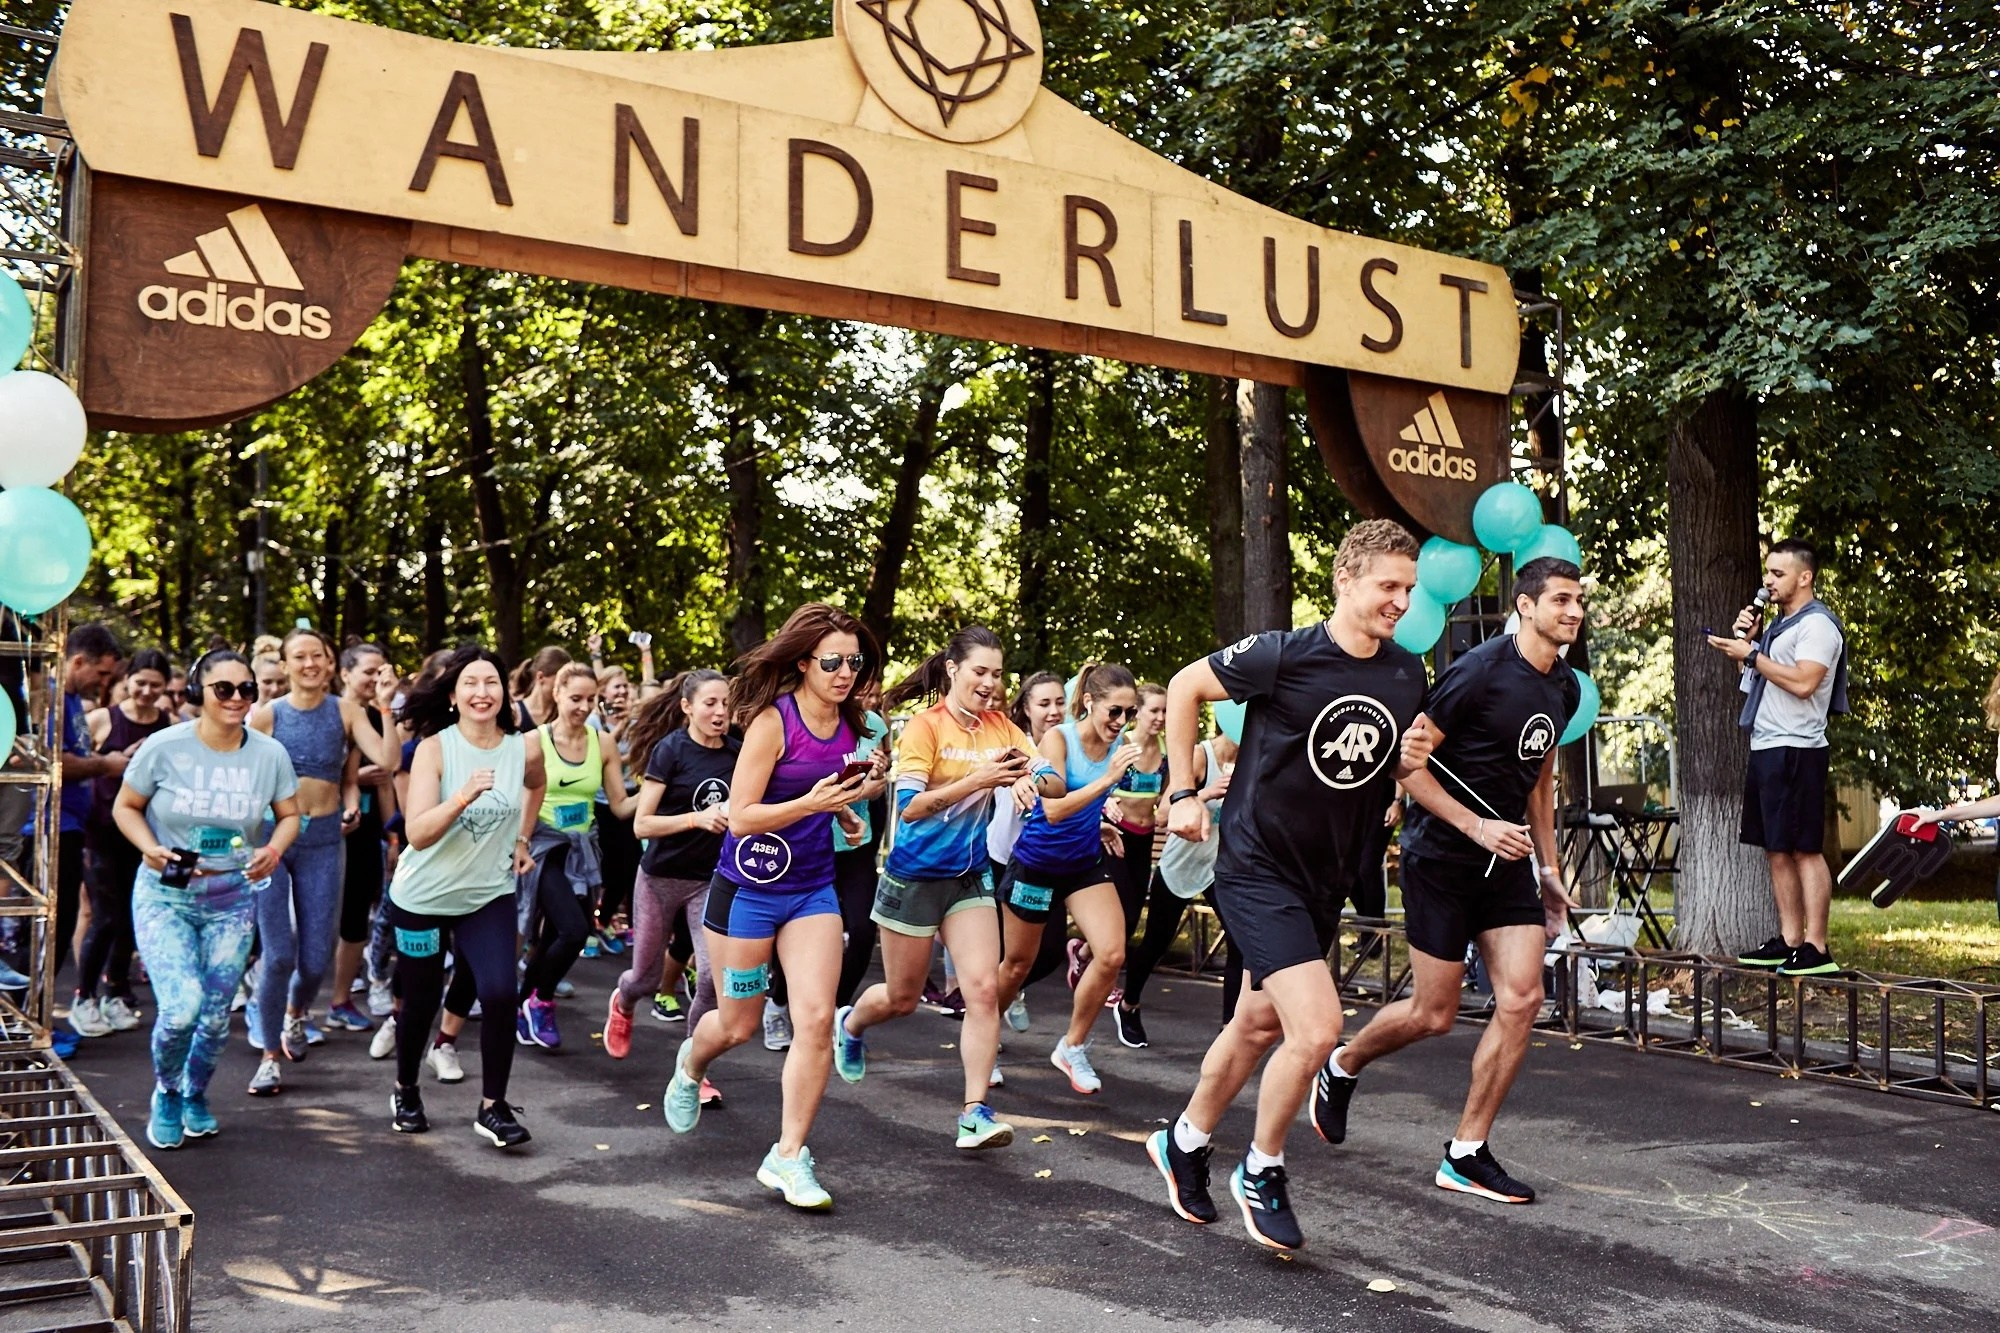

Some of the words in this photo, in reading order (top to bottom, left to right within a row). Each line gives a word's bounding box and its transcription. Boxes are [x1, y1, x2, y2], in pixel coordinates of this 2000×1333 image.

[170, 13, 1489, 370] WANDERLUST
[138, 281, 332, 340] adidas
[1388, 444, 1477, 482] adidas
[1320, 723, 1380, 762] AR
[1524, 729, 1549, 751] AR
[194, 765, 205, 790] I
[209, 766, 250, 793] AM
[171, 787, 262, 821] READY
[750, 842, 779, 856] ДЗЕН
[733, 980, 761, 993] 0255
